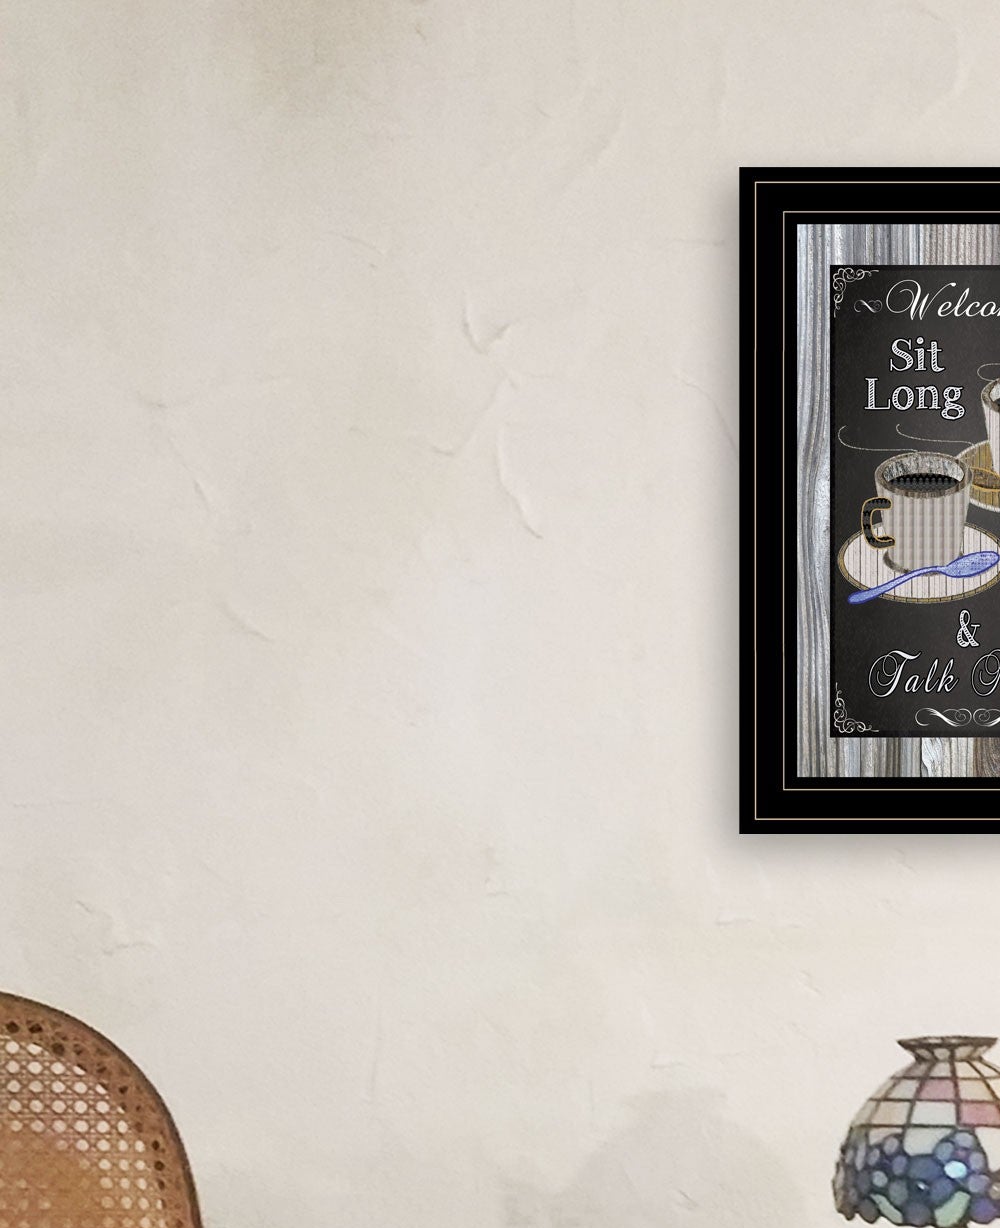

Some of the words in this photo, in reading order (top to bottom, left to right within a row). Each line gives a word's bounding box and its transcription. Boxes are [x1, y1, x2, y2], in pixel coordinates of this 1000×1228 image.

[890, 337, 944, 372] Sit
[864, 377, 965, 420] Long
[957, 610, 980, 647] &
[868, 650, 958, 698] Talk
